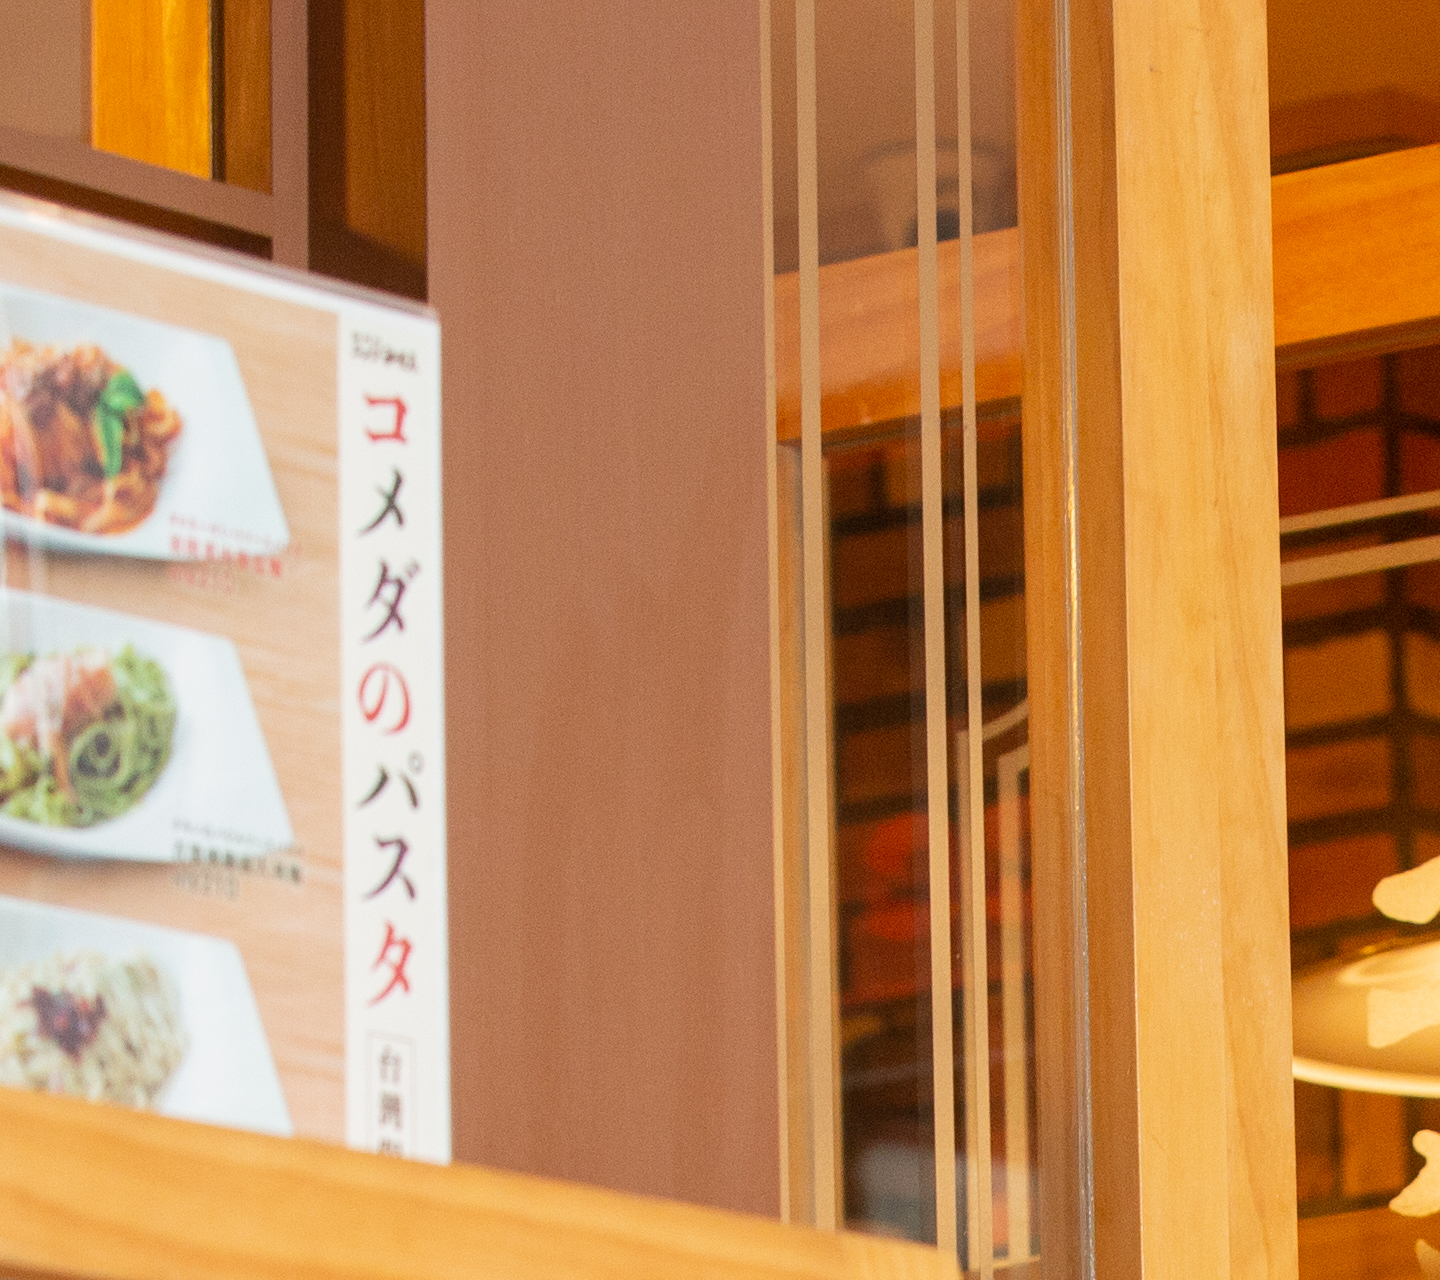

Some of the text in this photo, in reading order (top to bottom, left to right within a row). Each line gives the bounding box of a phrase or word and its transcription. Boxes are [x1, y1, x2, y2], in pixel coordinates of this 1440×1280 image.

[354, 389, 422, 1008] コメダのパスタ
